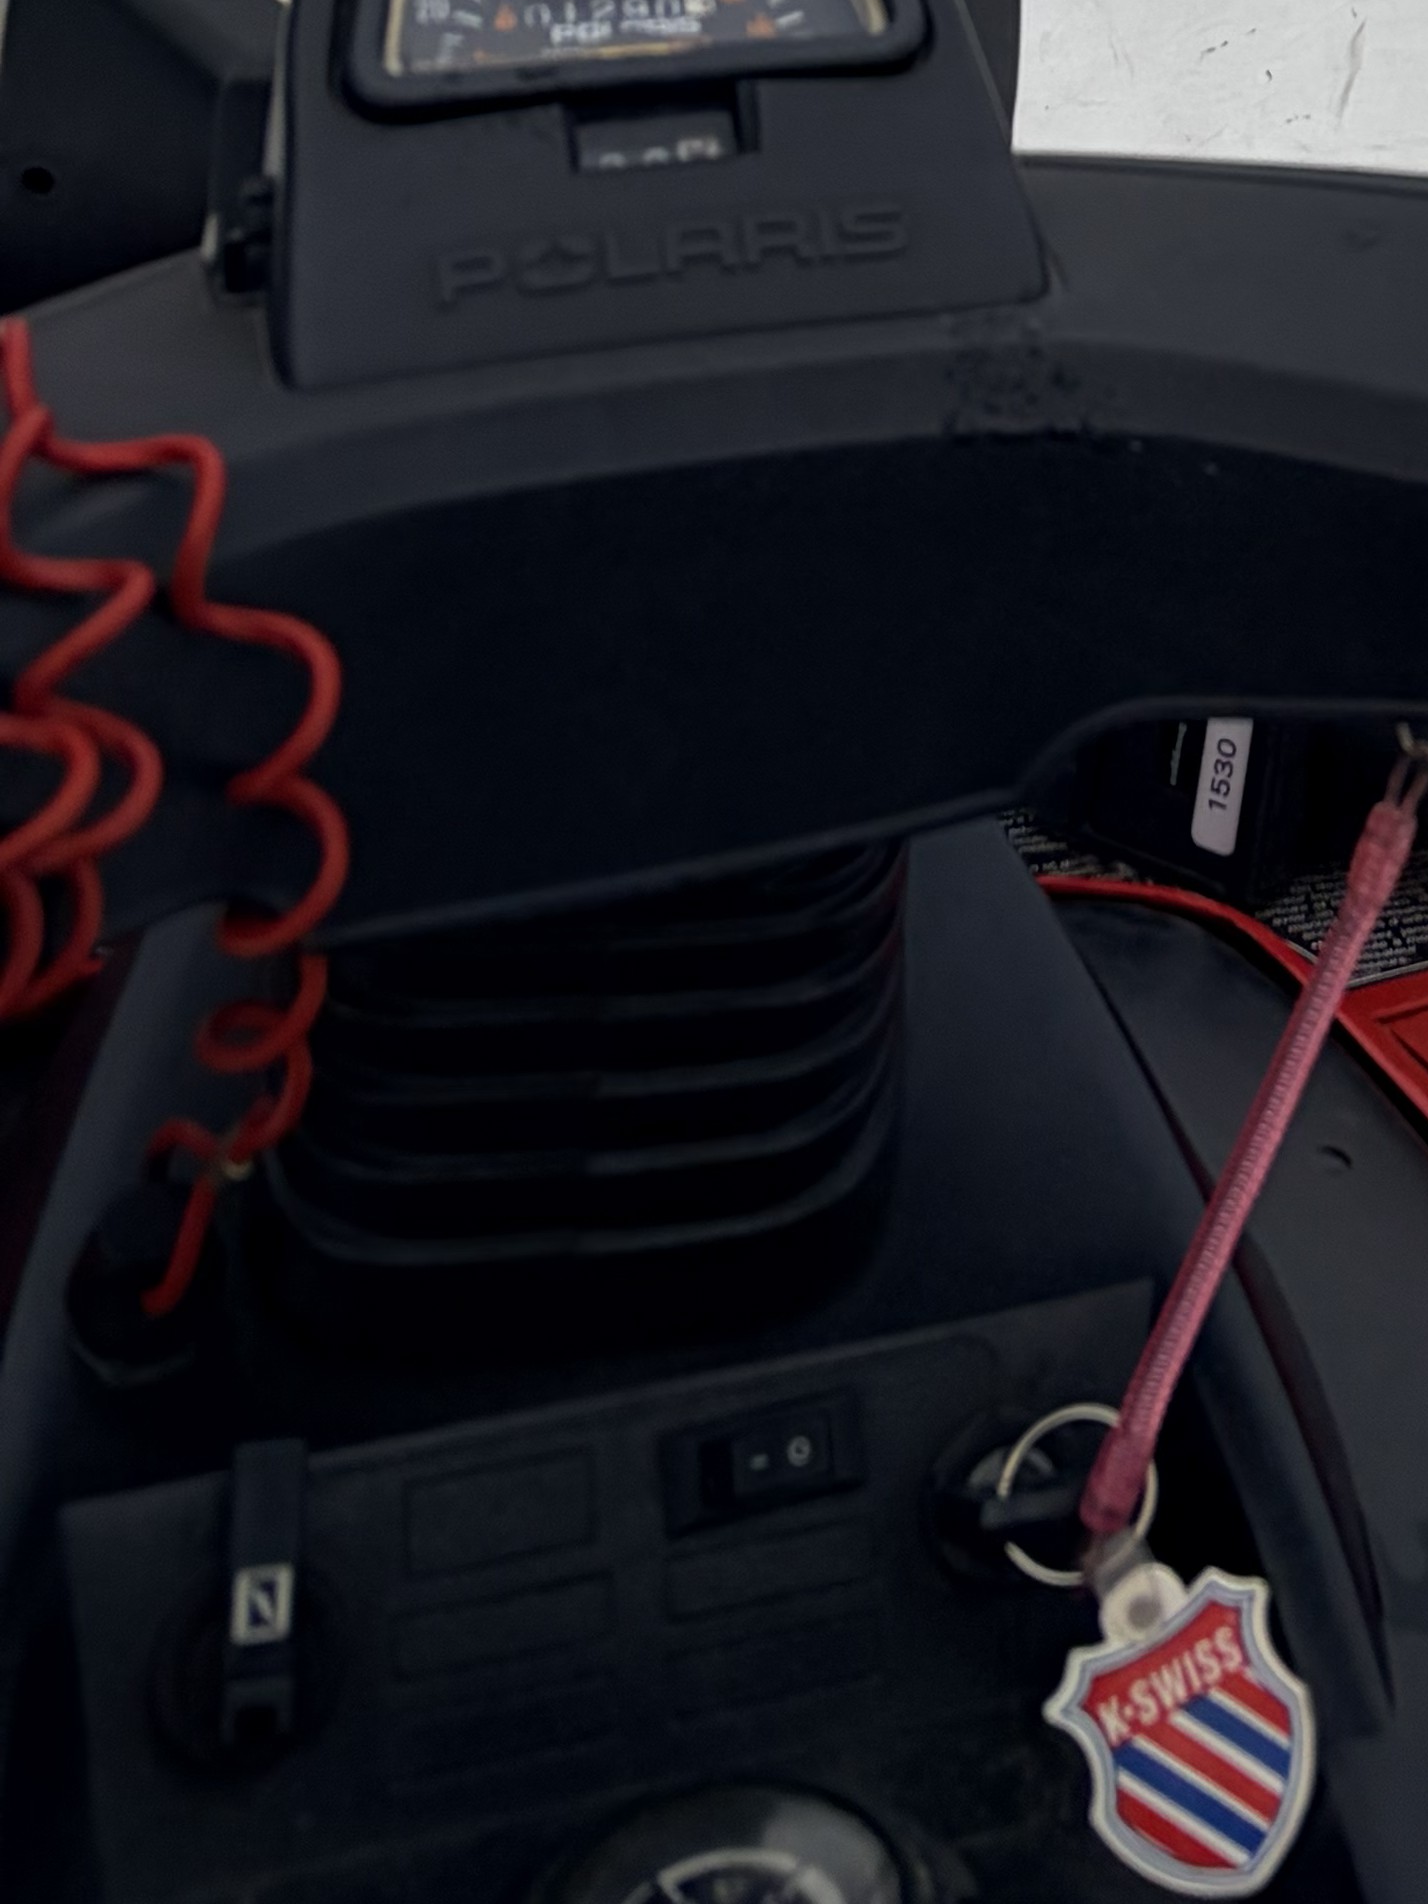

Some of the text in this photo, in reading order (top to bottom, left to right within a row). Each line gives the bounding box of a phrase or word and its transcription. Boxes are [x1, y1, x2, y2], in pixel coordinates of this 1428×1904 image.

[436, 207, 907, 309] POLARIS
[1208, 737, 1237, 812] 1530
[1098, 1626, 1244, 1747] K-SWISS
